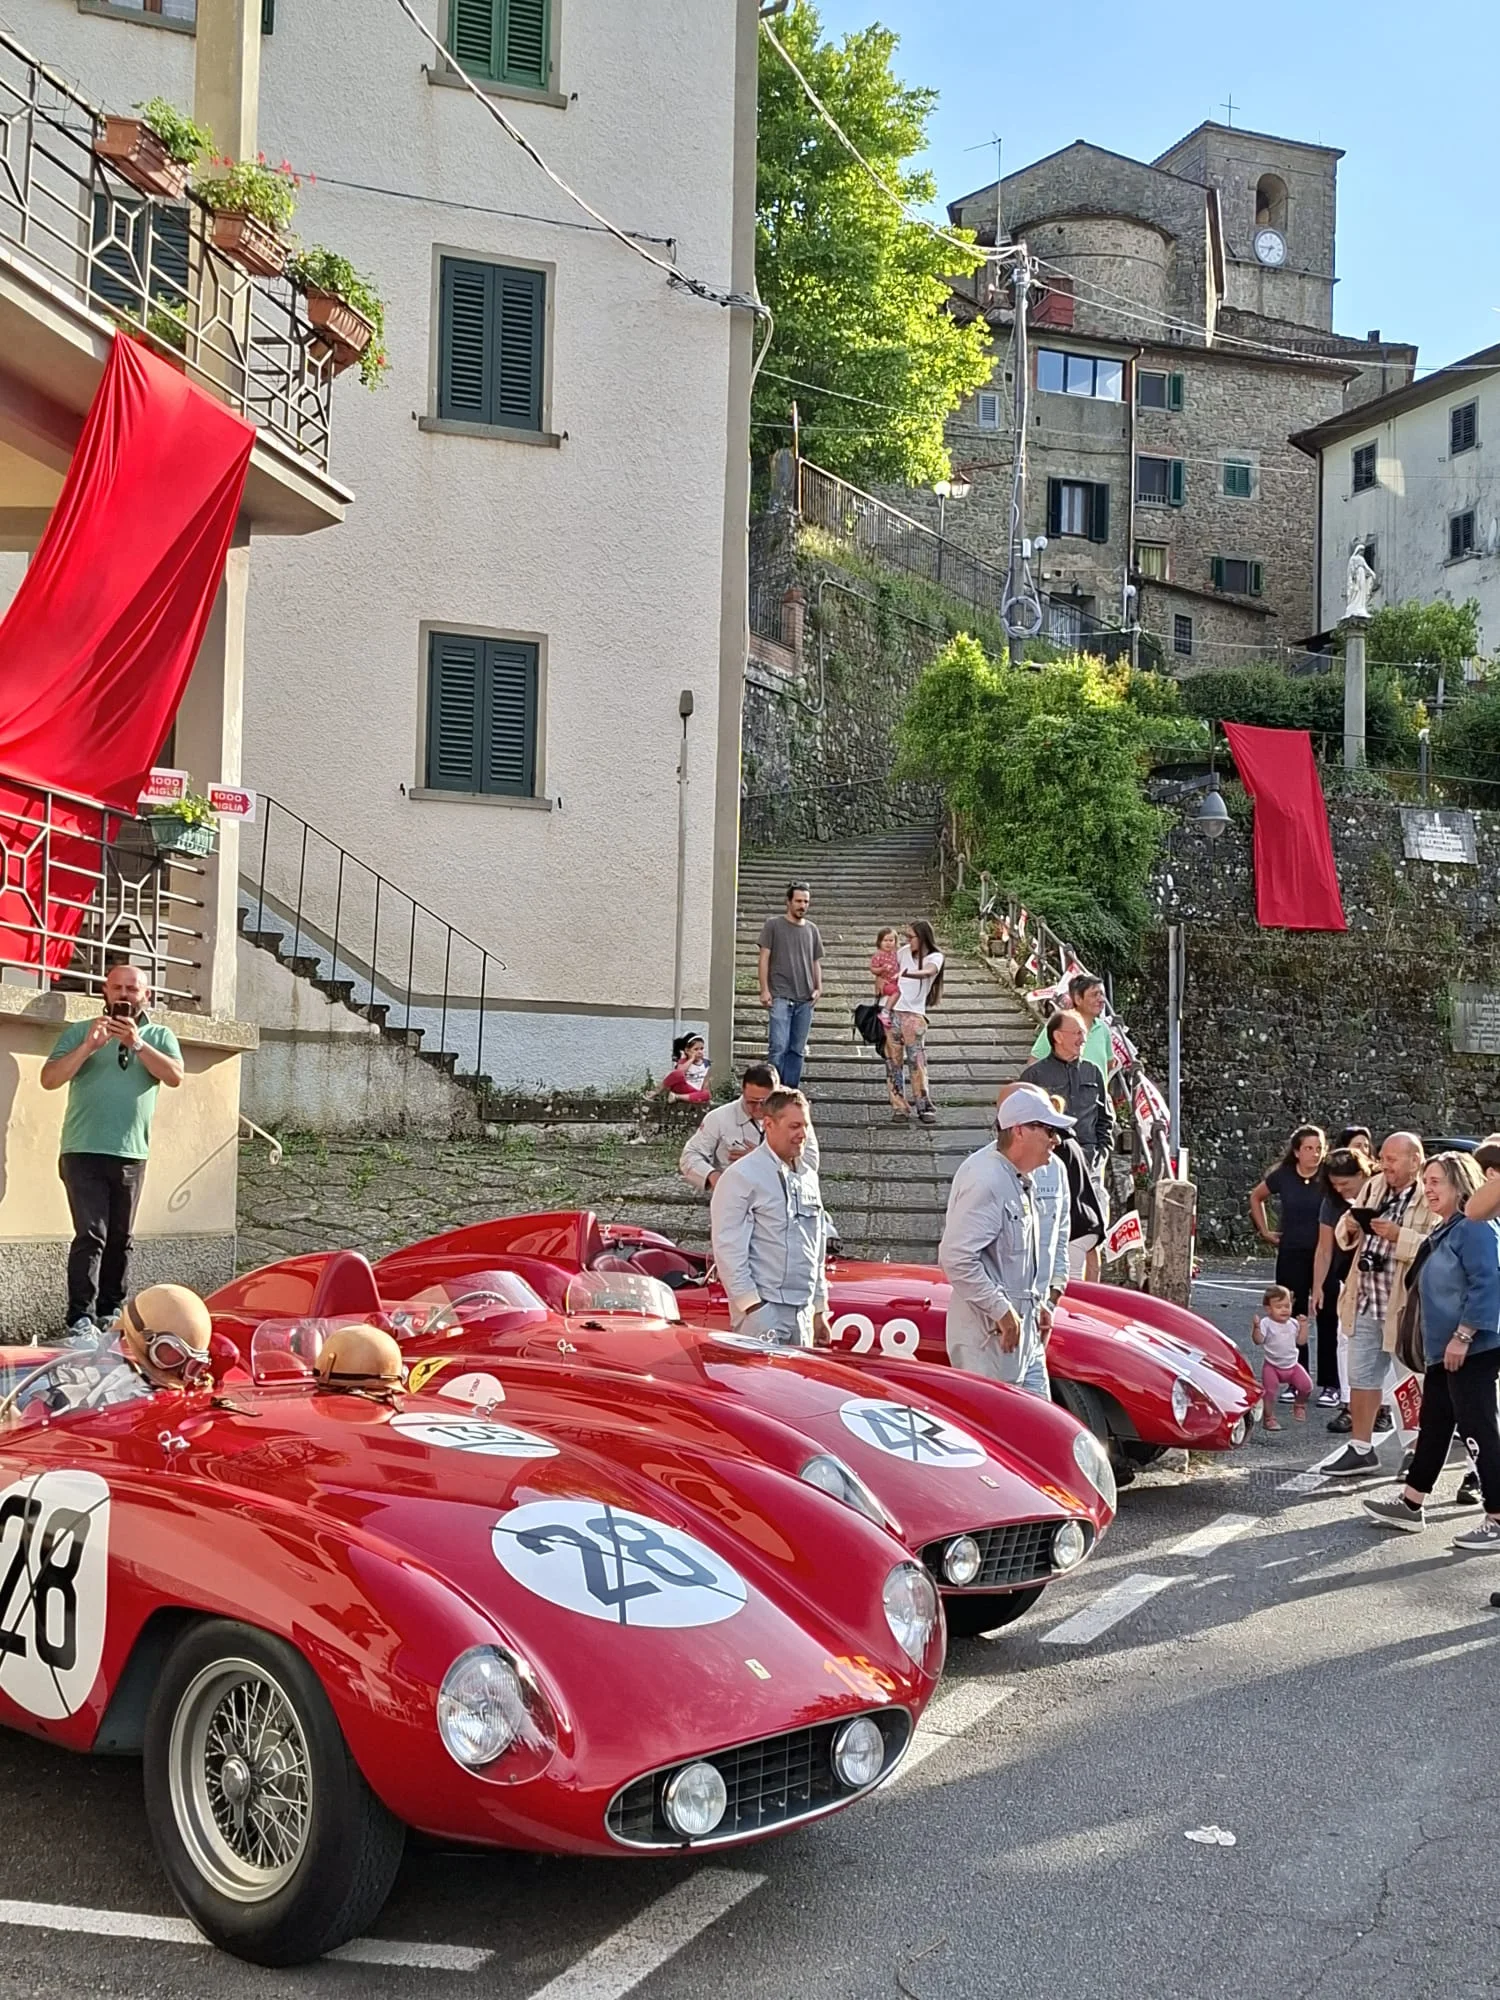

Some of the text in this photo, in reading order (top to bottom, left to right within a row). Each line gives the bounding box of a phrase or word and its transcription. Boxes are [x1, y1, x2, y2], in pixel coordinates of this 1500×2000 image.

[214, 792, 242, 802] 1000
[823, 1311, 920, 1360] 28
[1407, 1378, 1422, 1417] IGLIA
[426, 1425, 525, 1441] 135
[860, 1407, 982, 1457] 42
[0, 1494, 91, 1671] 28
[516, 1516, 718, 1606] 28
[824, 1655, 896, 1696] 135
